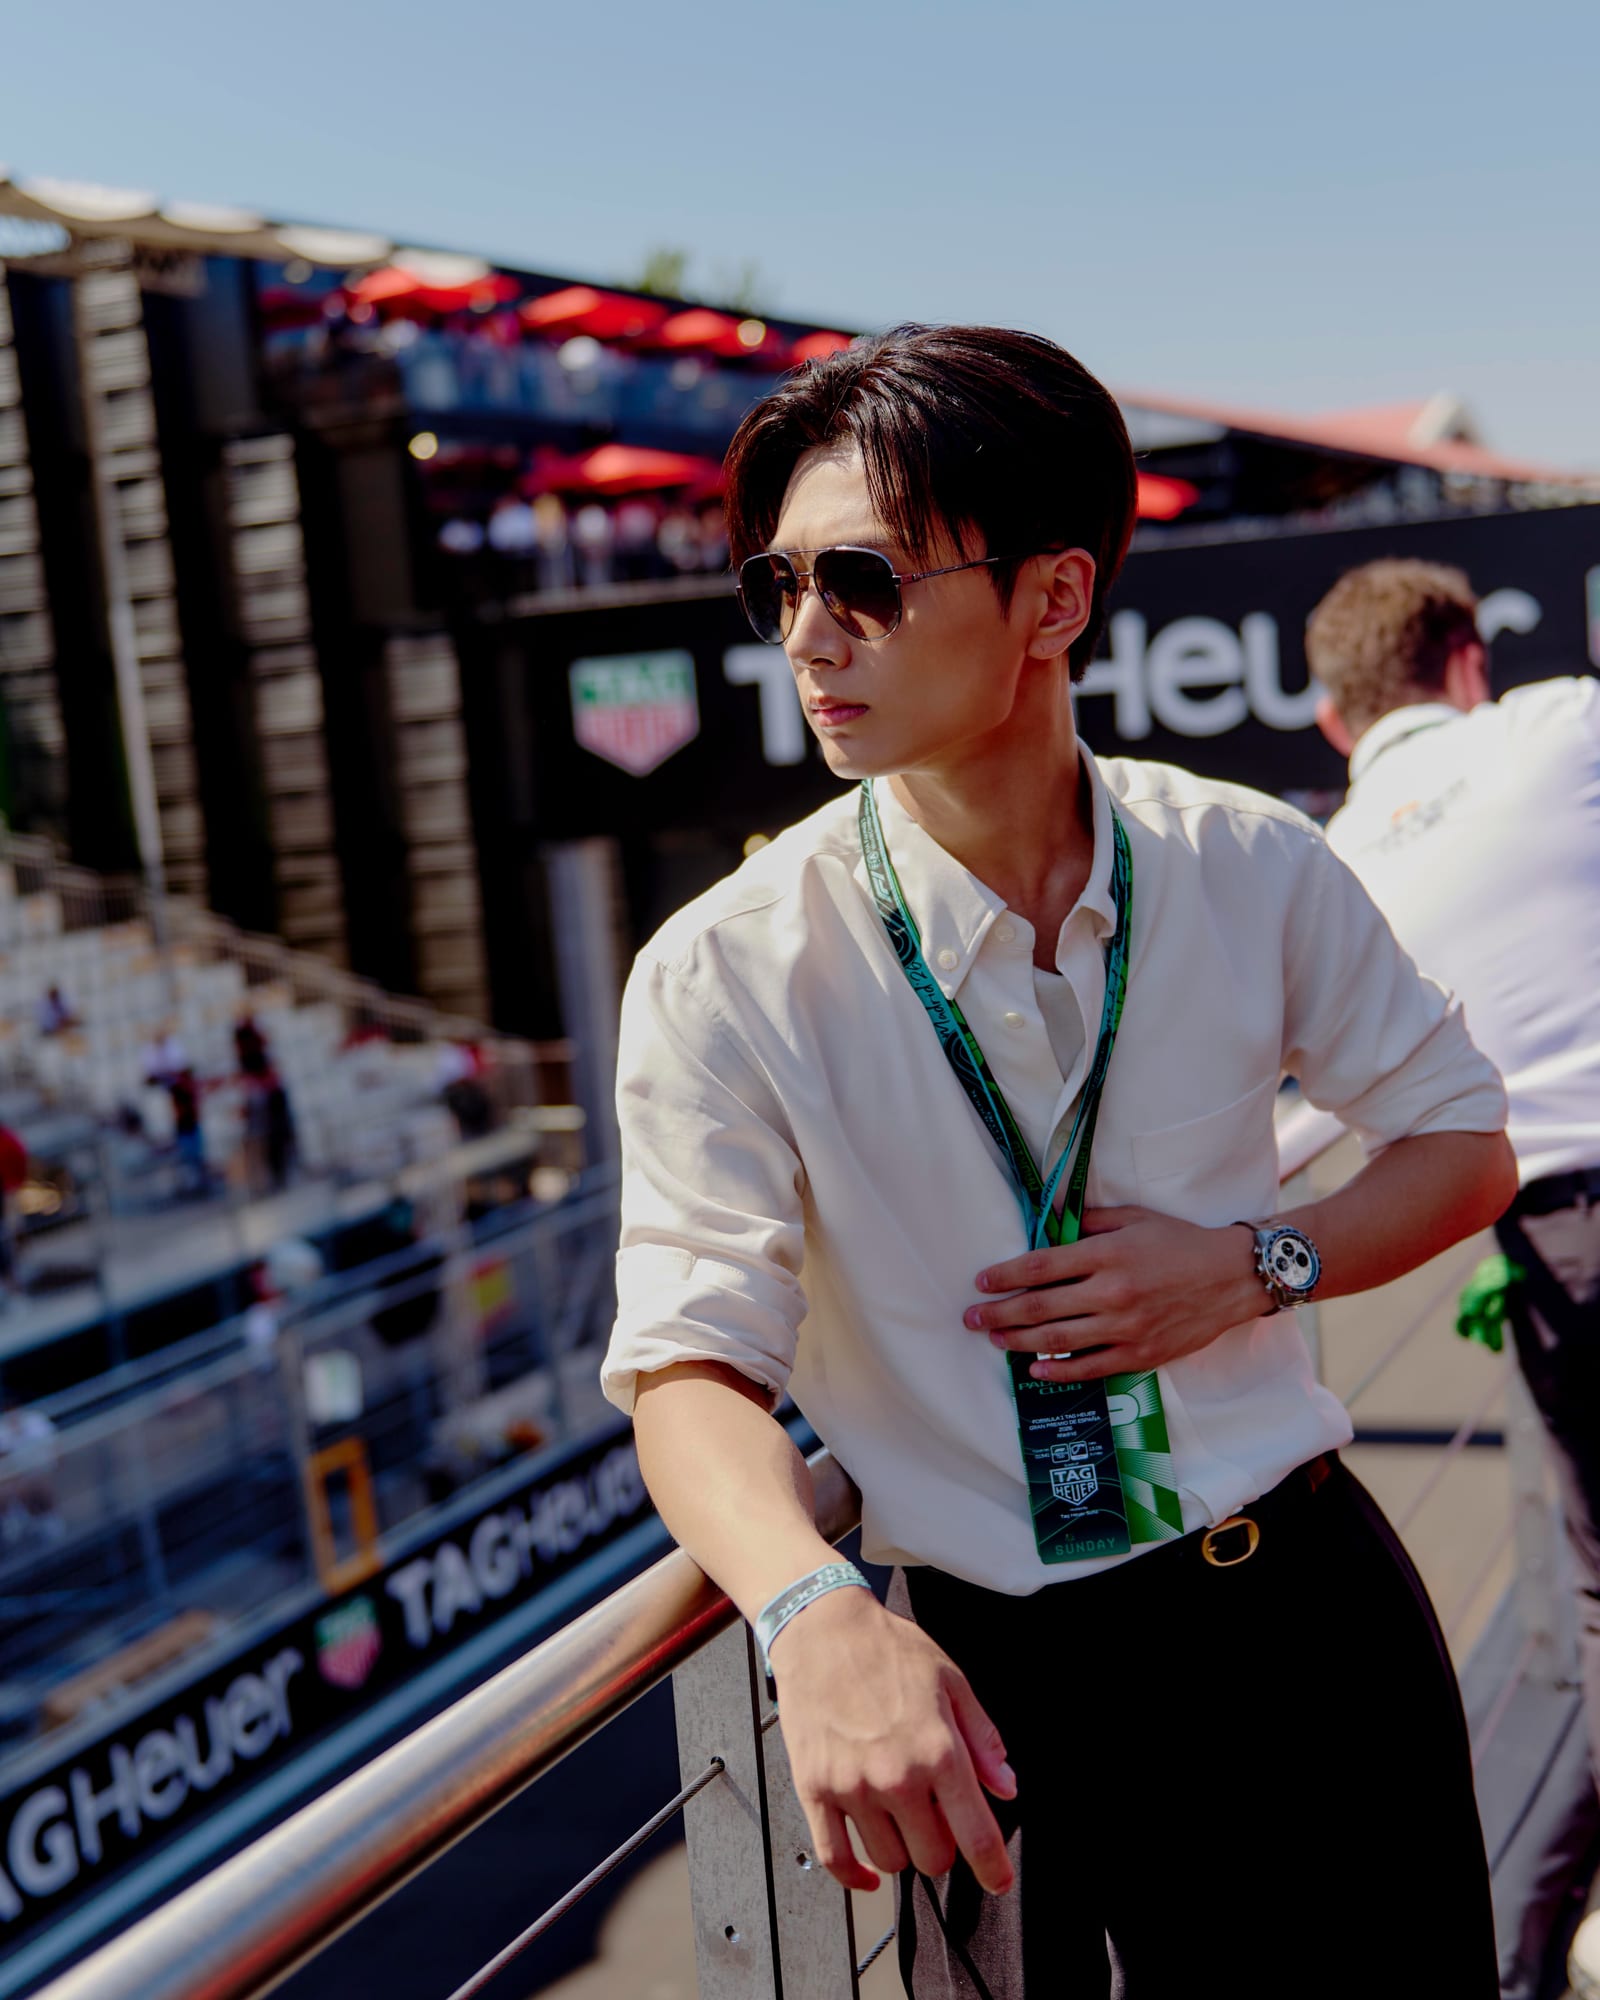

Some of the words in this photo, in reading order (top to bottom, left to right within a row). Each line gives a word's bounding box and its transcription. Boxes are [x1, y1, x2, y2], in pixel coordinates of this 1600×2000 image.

[1039, 1383, 1082, 1395] CLUB
[1054, 1467, 1092, 1483] TAG
[1055, 1482, 1095, 1502] HEUER
[1055, 1537, 1116, 1556] SUNDAY
